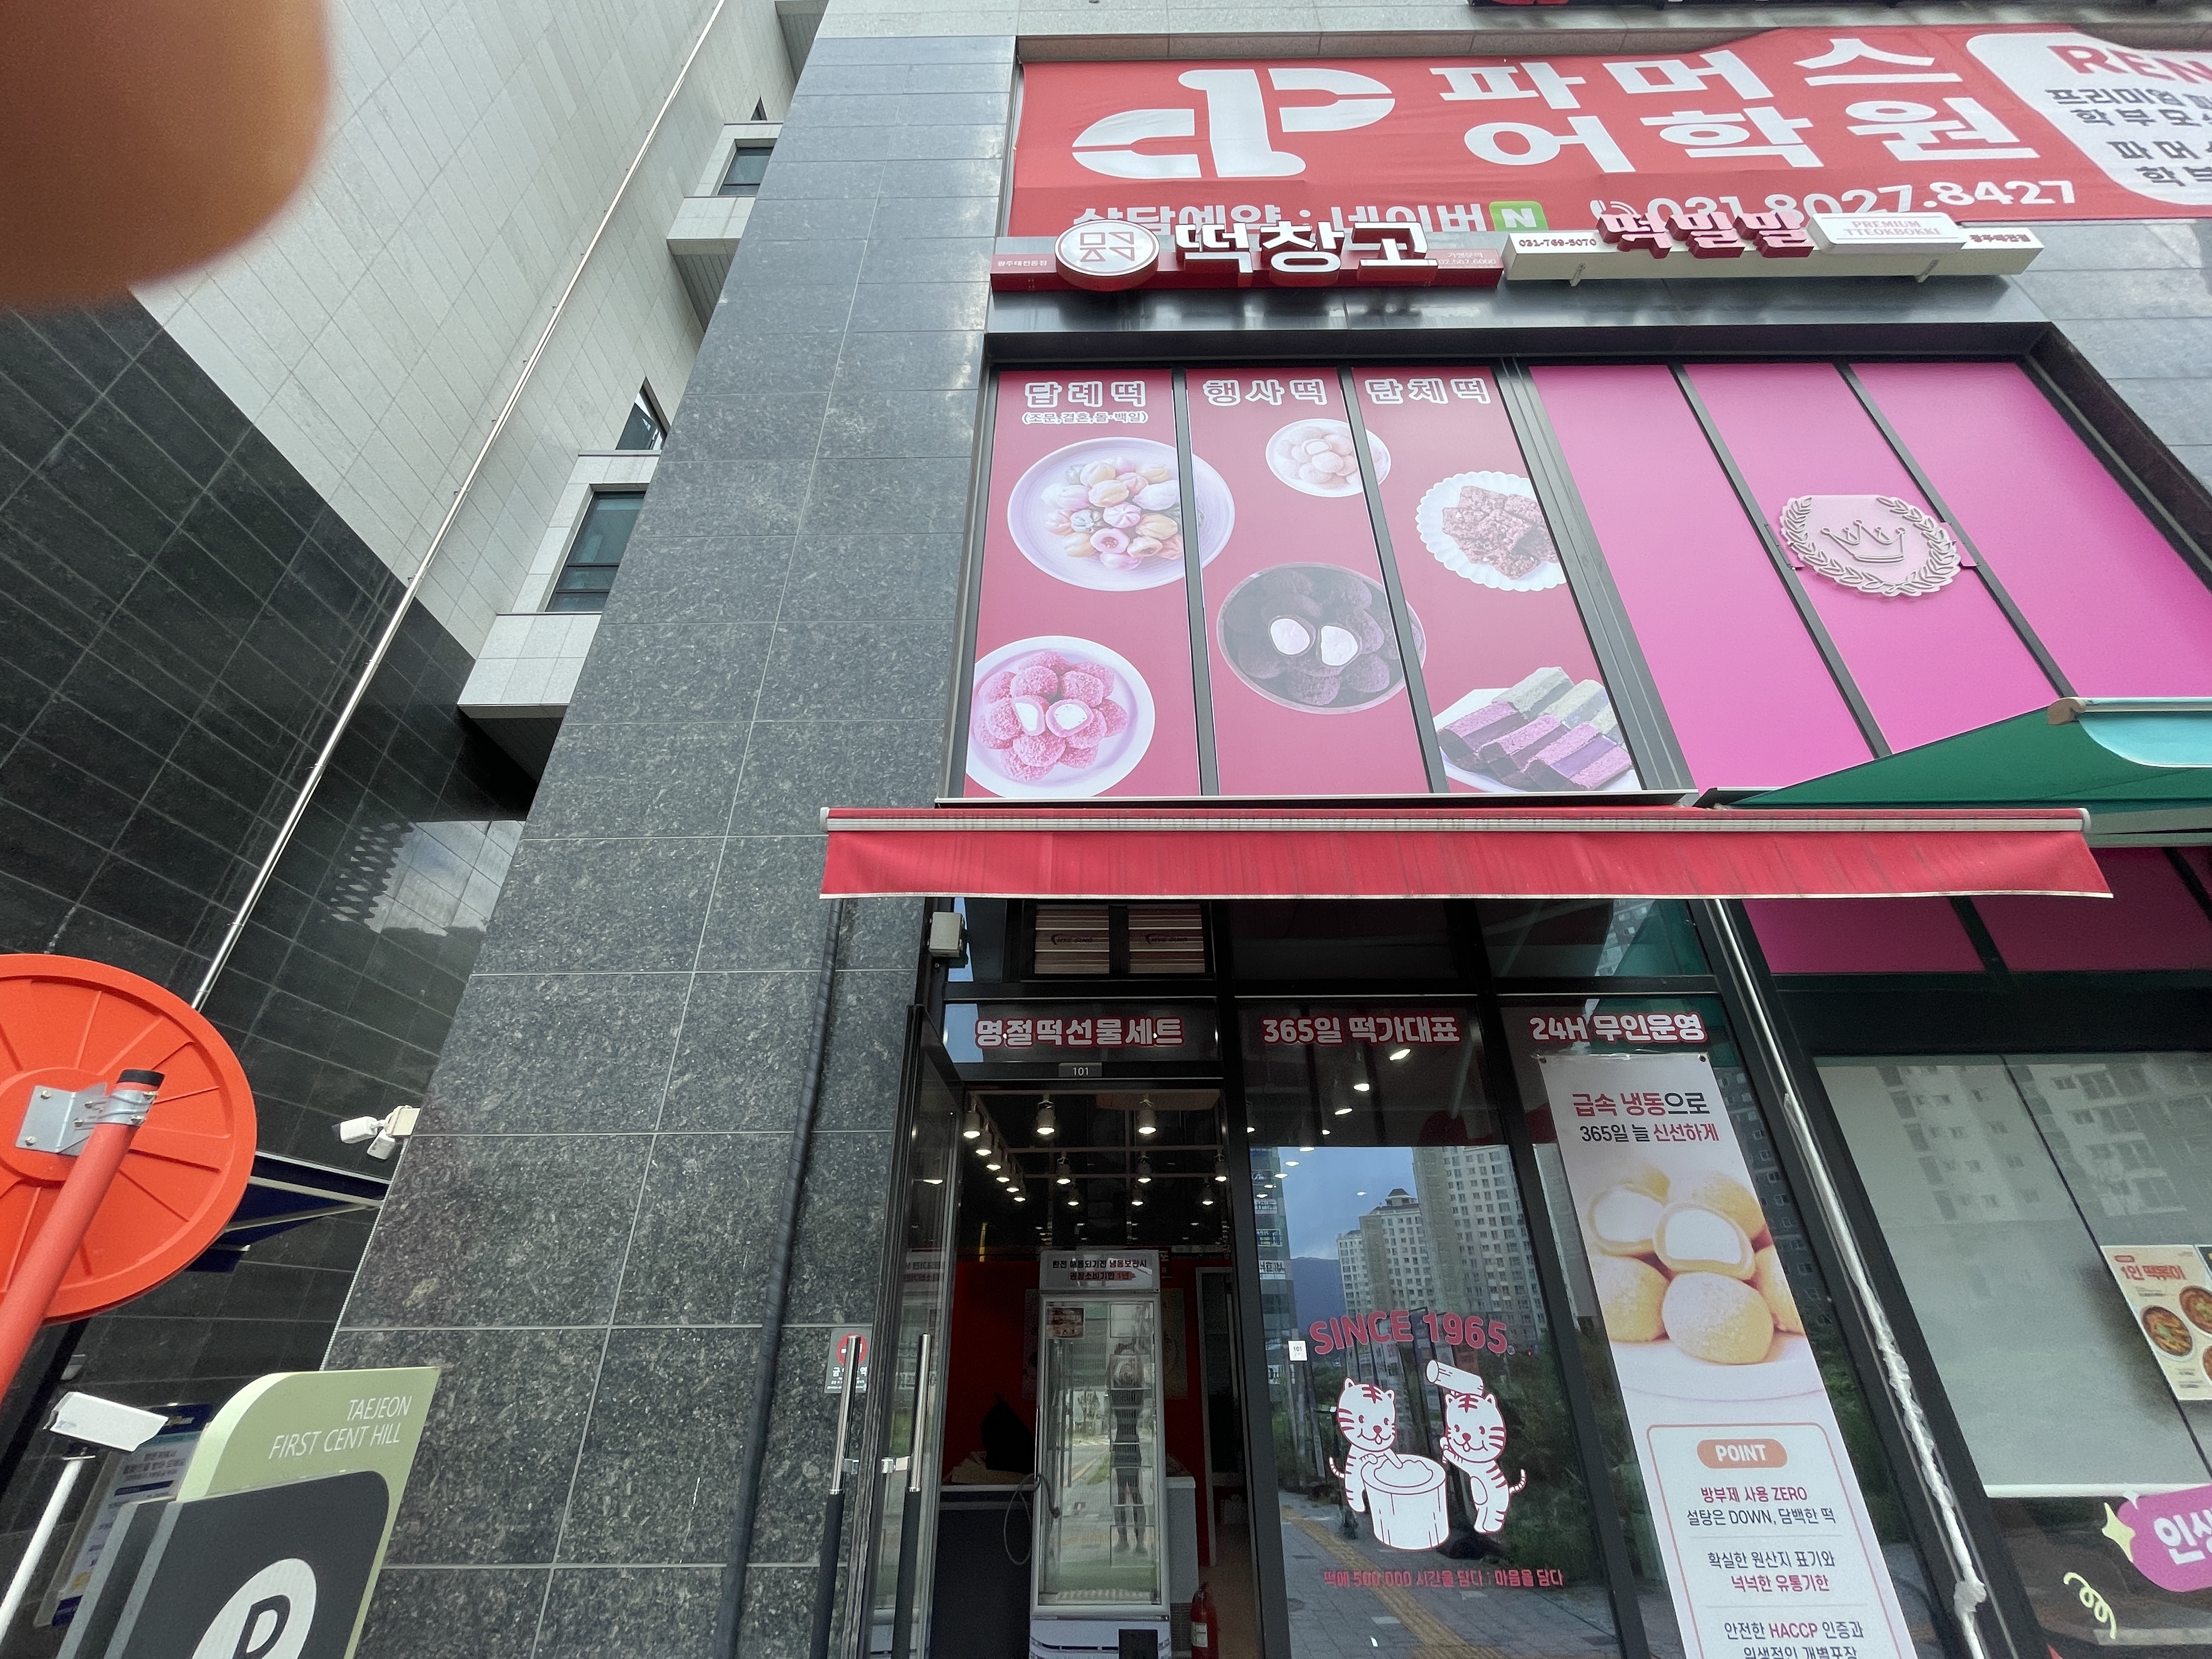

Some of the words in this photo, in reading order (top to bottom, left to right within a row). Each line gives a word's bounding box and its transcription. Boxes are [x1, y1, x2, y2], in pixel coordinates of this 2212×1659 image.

[1430, 38, 1963, 109] 파머스
[1464, 98, 2041, 173] 어학원
[1852, 220, 1921, 228] PREMIUM
[1175, 220, 1438, 274] 떡창고
[1025, 381, 1146, 408] 답례떡
[1203, 379, 1328, 406] 행사떡
[1365, 377, 1492, 405] 단체떡
[977, 1018, 1183, 1047] 명절떡선물세트
[1263, 1017, 1342, 1043] 365일
[1530, 1017, 1589, 1041] 24H
[1593, 1014, 1705, 1041] 무인운영
[1073, 1066, 1090, 1076] 101
[1572, 1093, 1618, 1117] 급속
[1620, 1092, 1711, 1116] 냉동으로
[1579, 1124, 1630, 1142] 365일
[1632, 1124, 1650, 1142] 늘
[1653, 1123, 1719, 1142] 신선하게
[1309, 1310, 1414, 1355] SINCE
[1423, 1311, 1509, 1355] 1965
[346, 1395, 413, 1421] TAEJEON
[268, 1431, 323, 1459] FIRST
[323, 1425, 370, 1453] CENT
[370, 1422, 401, 1447] HILL
[1715, 1444, 1767, 1463] POINT
[1701, 1487, 1740, 1503] 방부제
[1744, 1486, 1769, 1502] 사용
[1771, 1486, 1808, 1501] ZERO
[1687, 1509, 1726, 1526] 설탕은
[1728, 1509, 1777, 1525] DOWN,
[1778, 1508, 1819, 1525] 담백한
[1820, 1508, 1836, 1524] 떡
[1707, 1551, 1749, 1569] 확실한
[1751, 1551, 1792, 1568] 원산지
[1794, 1550, 1836, 1567] 표기와
[1731, 1575, 1773, 1592] 넉넉한
[1775, 1574, 1830, 1592] 유통기한
[232, 1594, 291, 1659] P
[1724, 1622, 1766, 1640] 안전한
[1768, 1622, 1818, 1639] HACCP
[1822, 1621, 1864, 1639] 인증과
